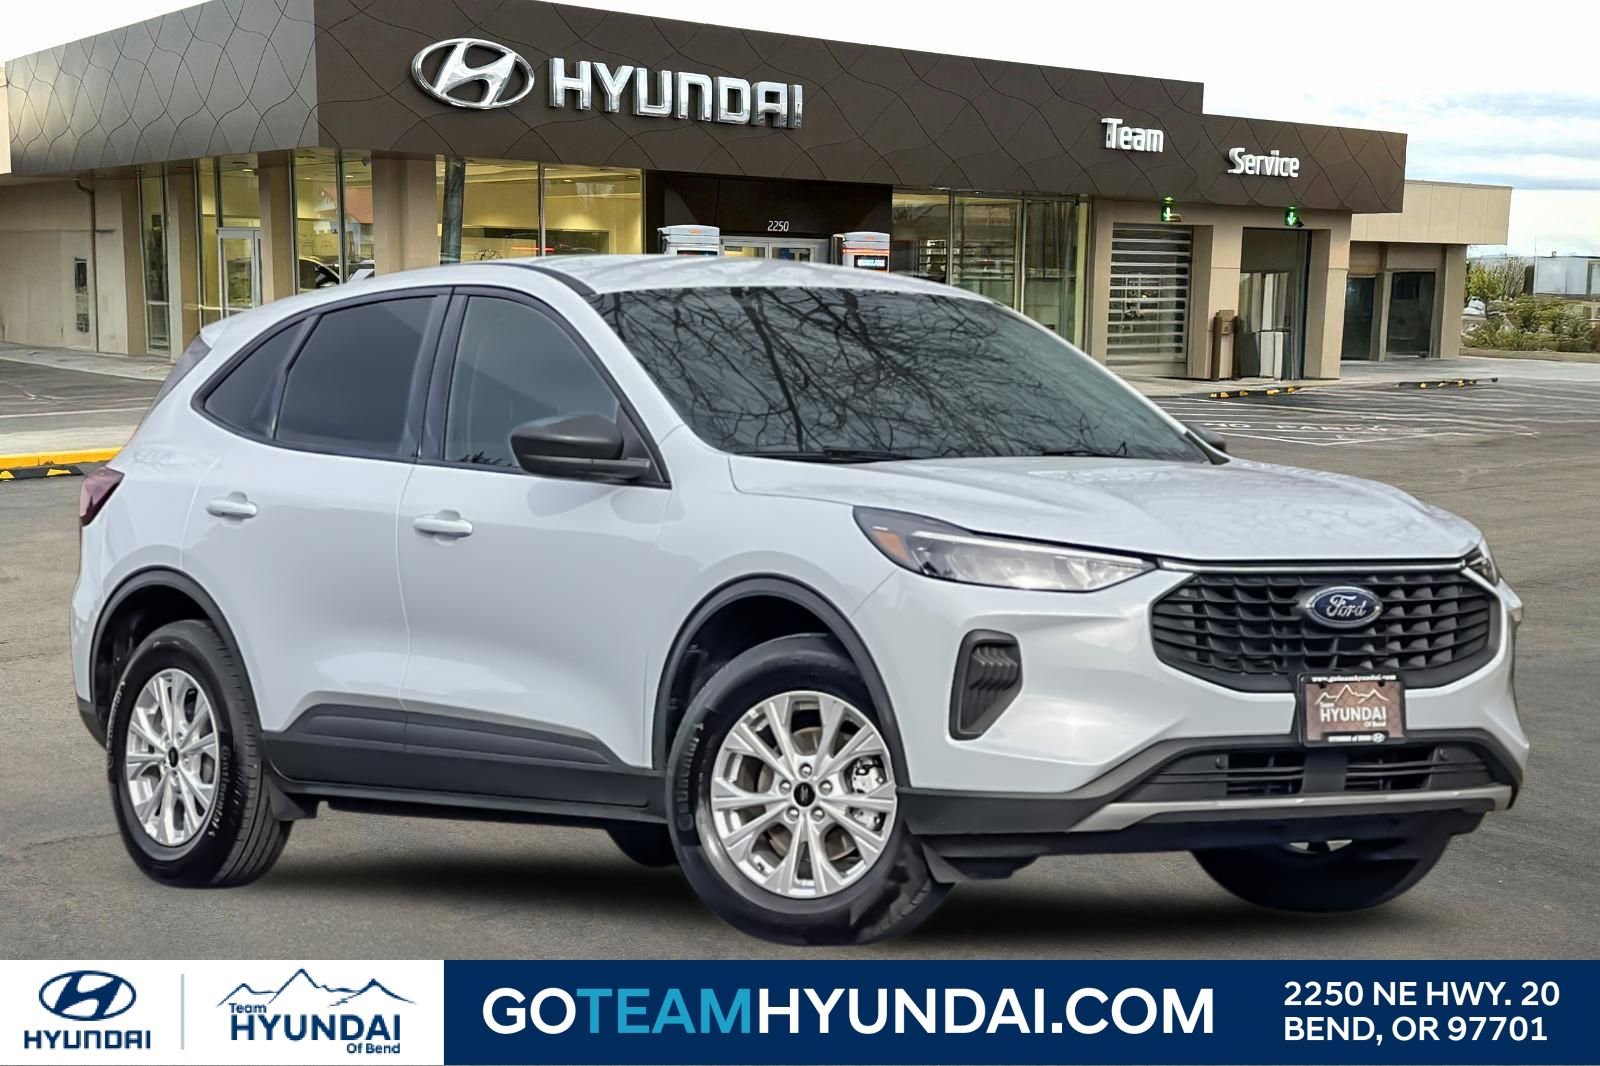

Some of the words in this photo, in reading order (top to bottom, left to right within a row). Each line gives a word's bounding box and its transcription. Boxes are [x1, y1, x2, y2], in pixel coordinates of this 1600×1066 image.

[548, 56, 804, 129] HYUNDAI
[1101, 117, 1164, 153] Team
[1227, 146, 1300, 178] Service
[767, 220, 790, 232] 2250
[1326, 594, 1367, 617] Ford
[1320, 706, 1386, 722] HYUNDAI
